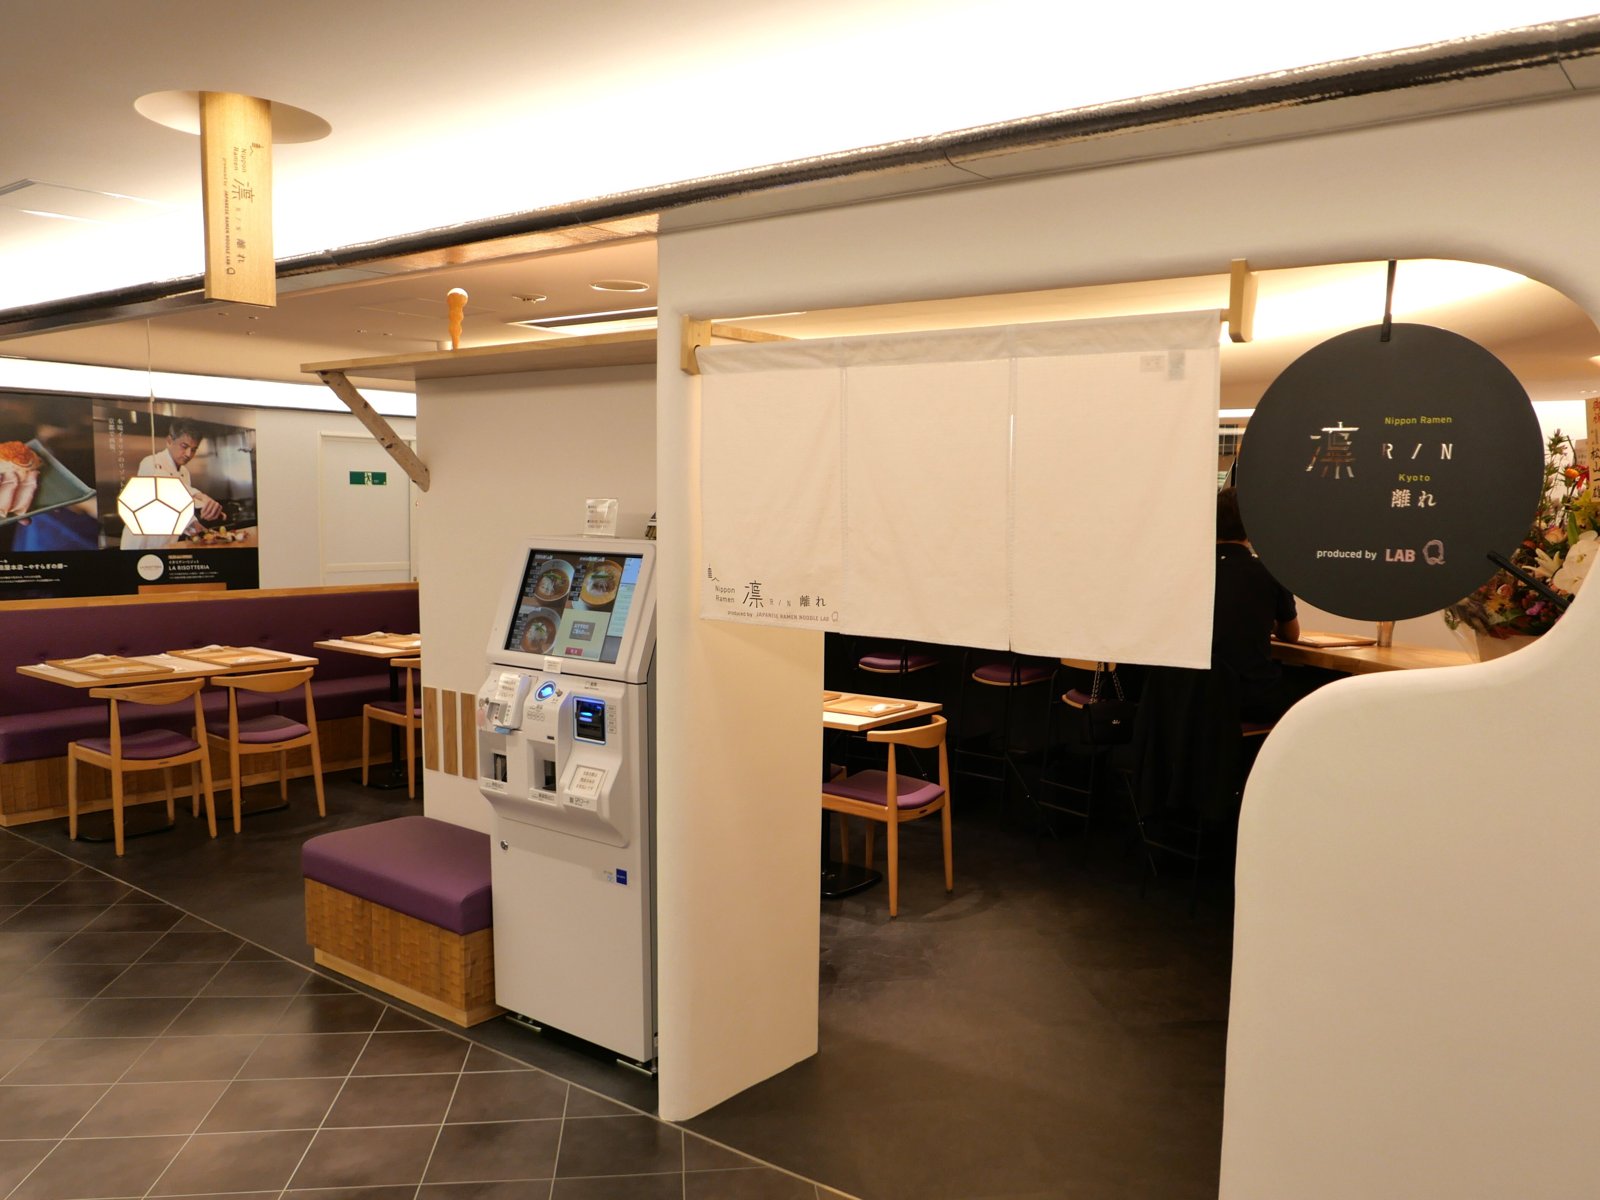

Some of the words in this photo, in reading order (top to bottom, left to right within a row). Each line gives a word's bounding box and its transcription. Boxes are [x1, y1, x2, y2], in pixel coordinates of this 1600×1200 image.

[1384, 416, 1418, 426] Nippon
[1420, 415, 1453, 425] Ramen
[1398, 473, 1431, 483] Kyoto
[1391, 488, 1437, 508] 離れ
[1316, 549, 1362, 559] produced
[1364, 549, 1377, 561] by
[1385, 549, 1416, 563] LAB
[715, 585, 736, 594] Nippon
[715, 594, 735, 603] Ramen
[799, 594, 827, 607] 離れ
